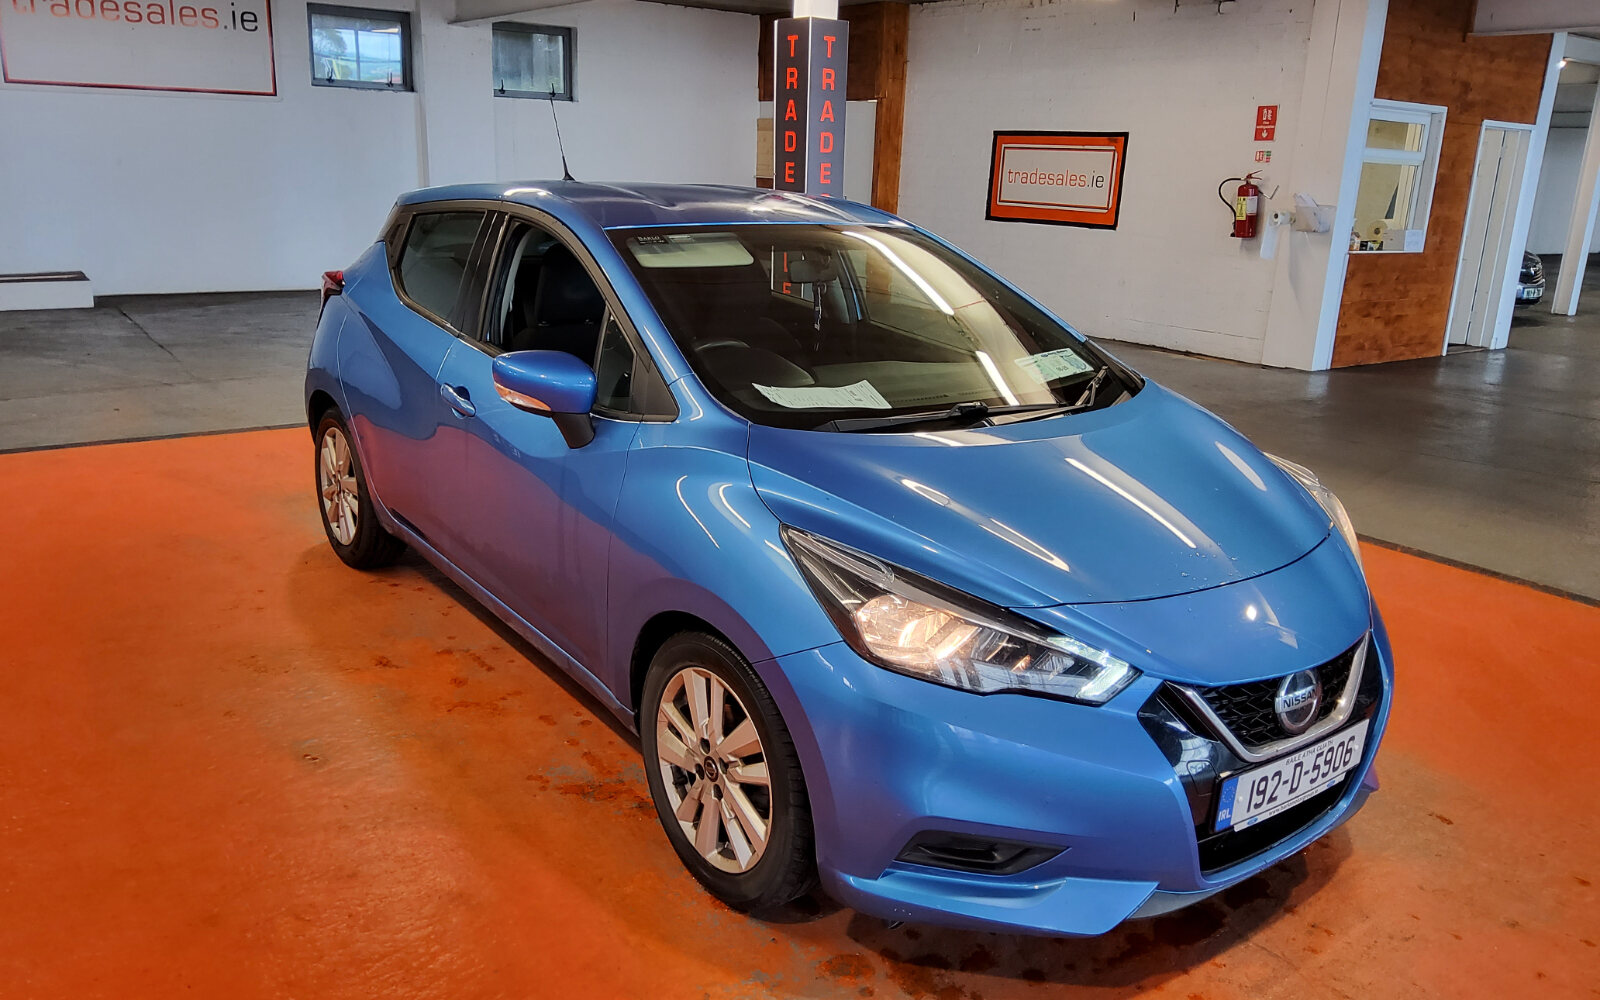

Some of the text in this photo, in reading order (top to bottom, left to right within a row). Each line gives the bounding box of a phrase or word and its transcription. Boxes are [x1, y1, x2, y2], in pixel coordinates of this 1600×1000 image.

[1007, 167, 1105, 189] tradesales.ie
[1283, 687, 1317, 709] NISSAN
[1247, 735, 1356, 813] 192-D-5906
[1218, 807, 1232, 823] IRL
